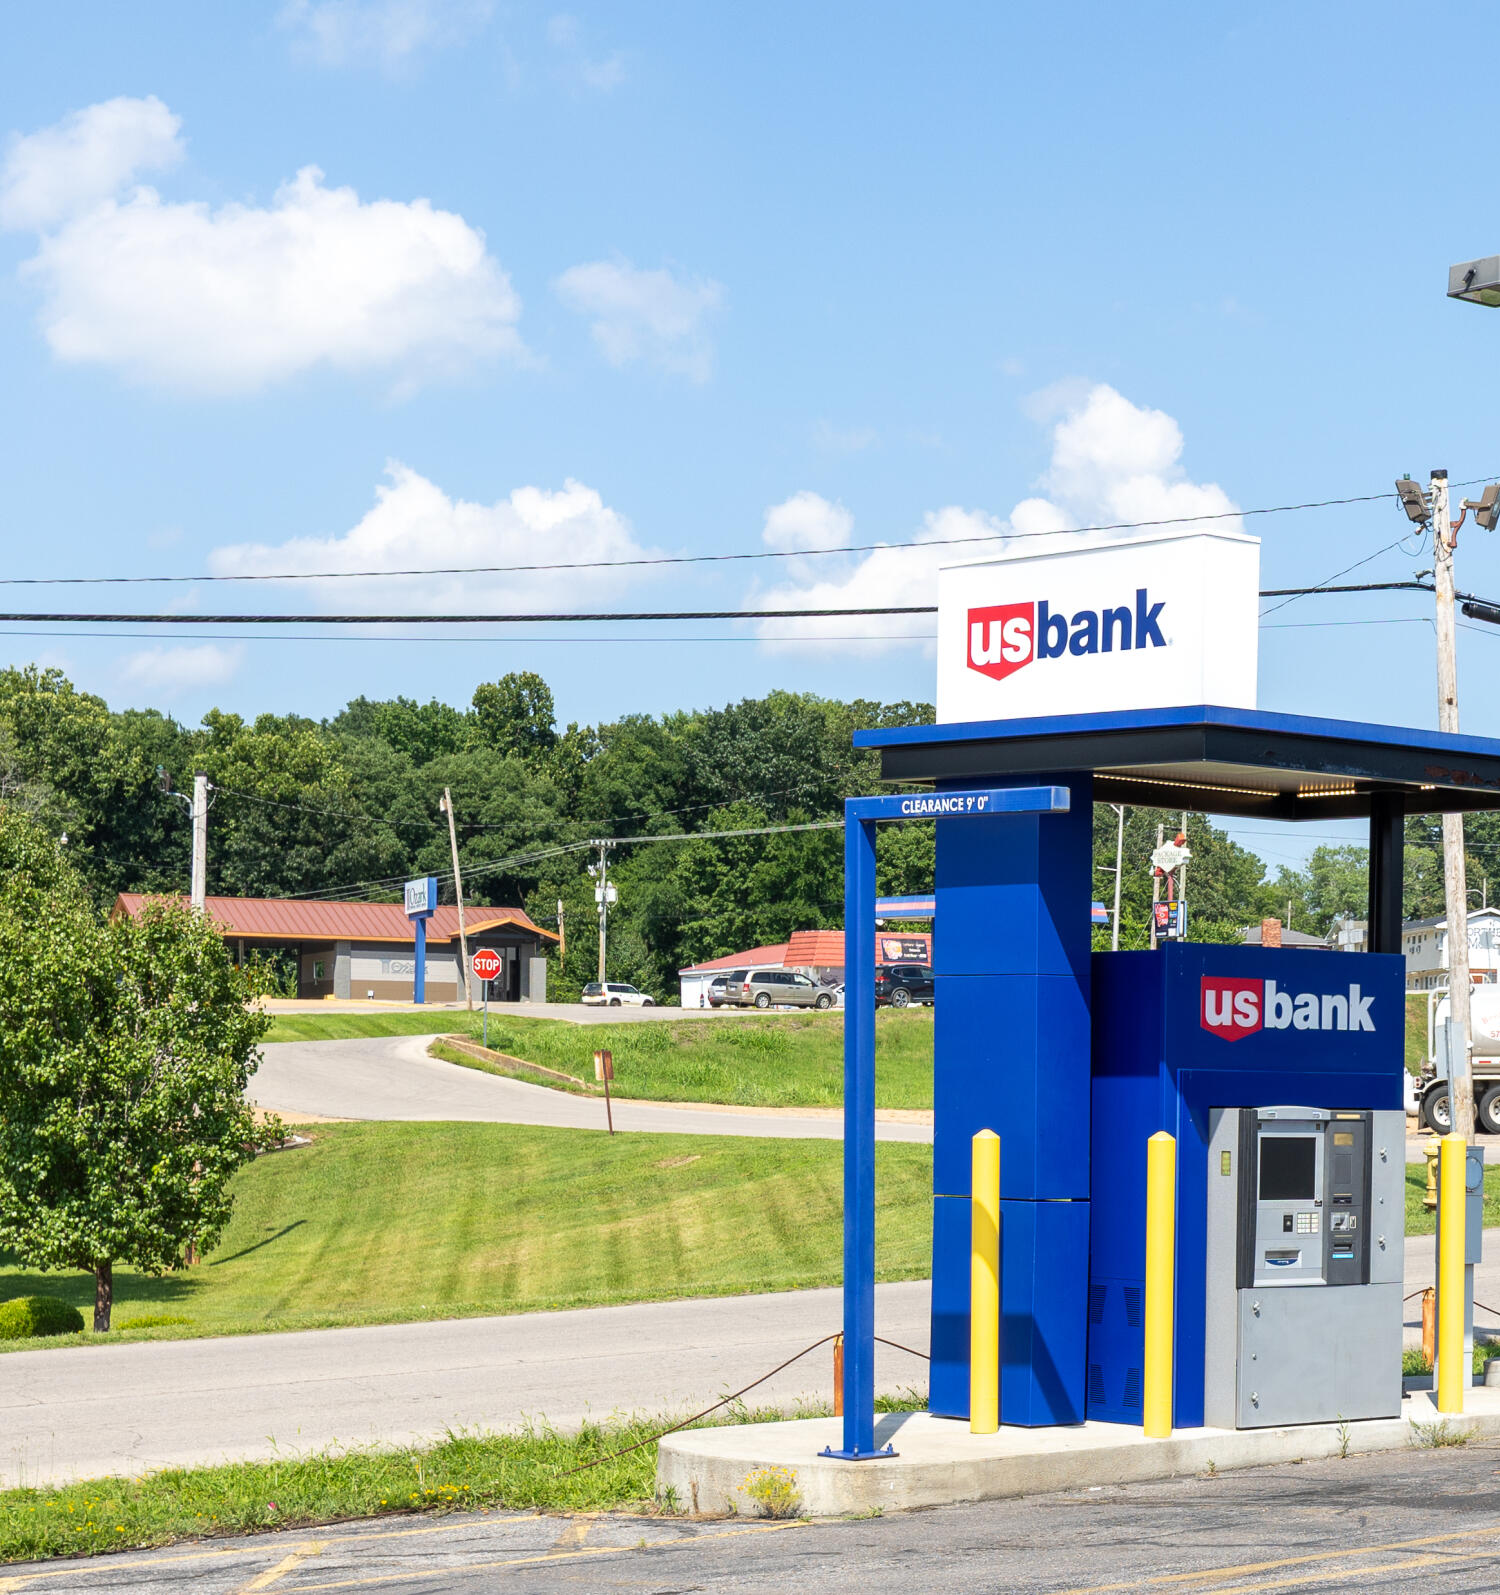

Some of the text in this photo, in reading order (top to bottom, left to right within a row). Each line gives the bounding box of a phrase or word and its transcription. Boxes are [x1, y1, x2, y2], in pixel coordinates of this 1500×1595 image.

[902, 797, 964, 814] CLEARANCE
[966, 797, 976, 811] 9'
[410, 883, 427, 906] Ozark
[474, 958, 500, 971] STOP
